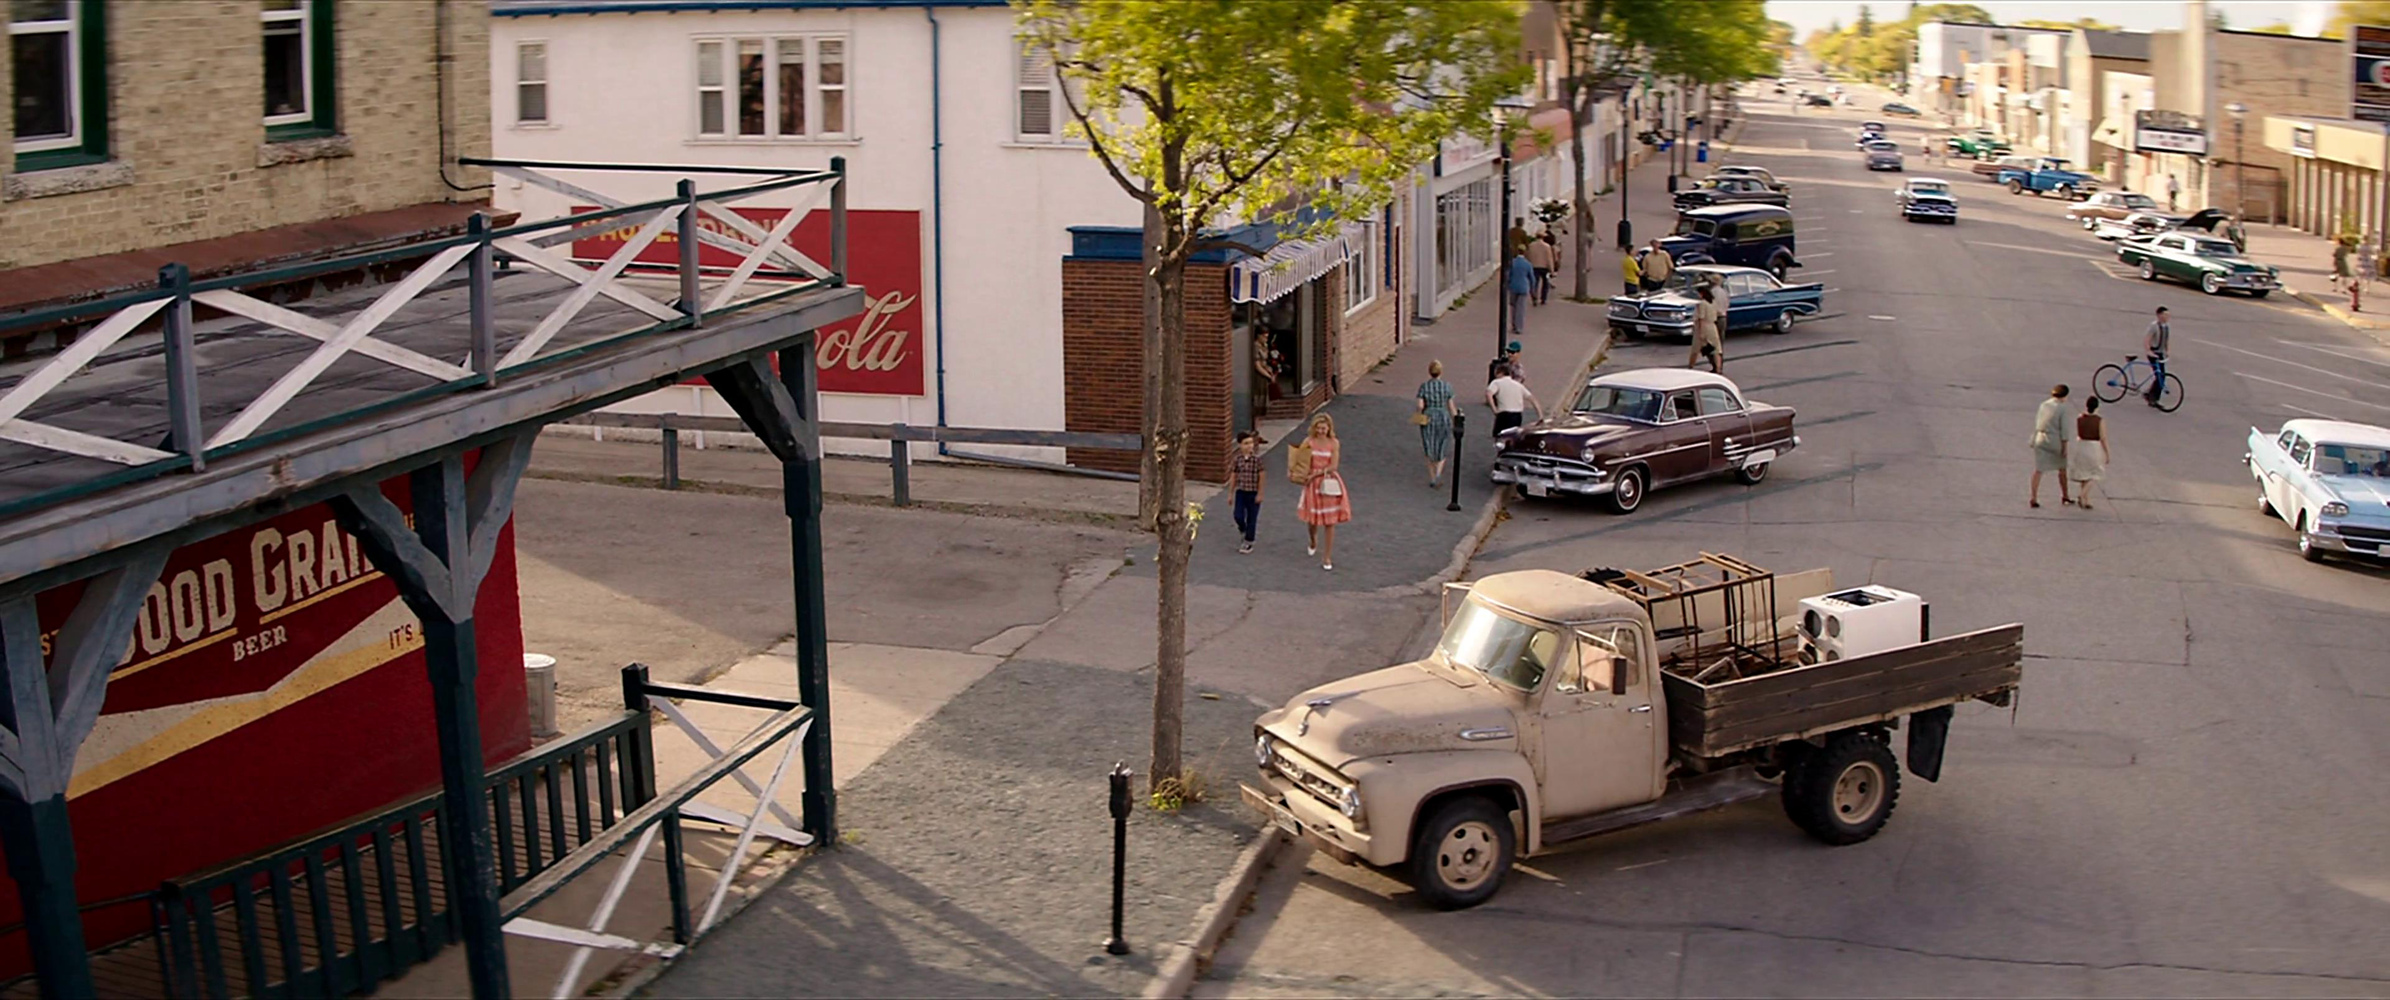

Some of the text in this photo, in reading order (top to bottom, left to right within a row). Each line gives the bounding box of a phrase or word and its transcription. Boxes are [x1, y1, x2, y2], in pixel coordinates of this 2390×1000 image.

[814, 291, 917, 371] ola
[250, 519, 375, 613] GRAI
[233, 625, 288, 662] BEER
[389, 624, 413, 649] IT'S
